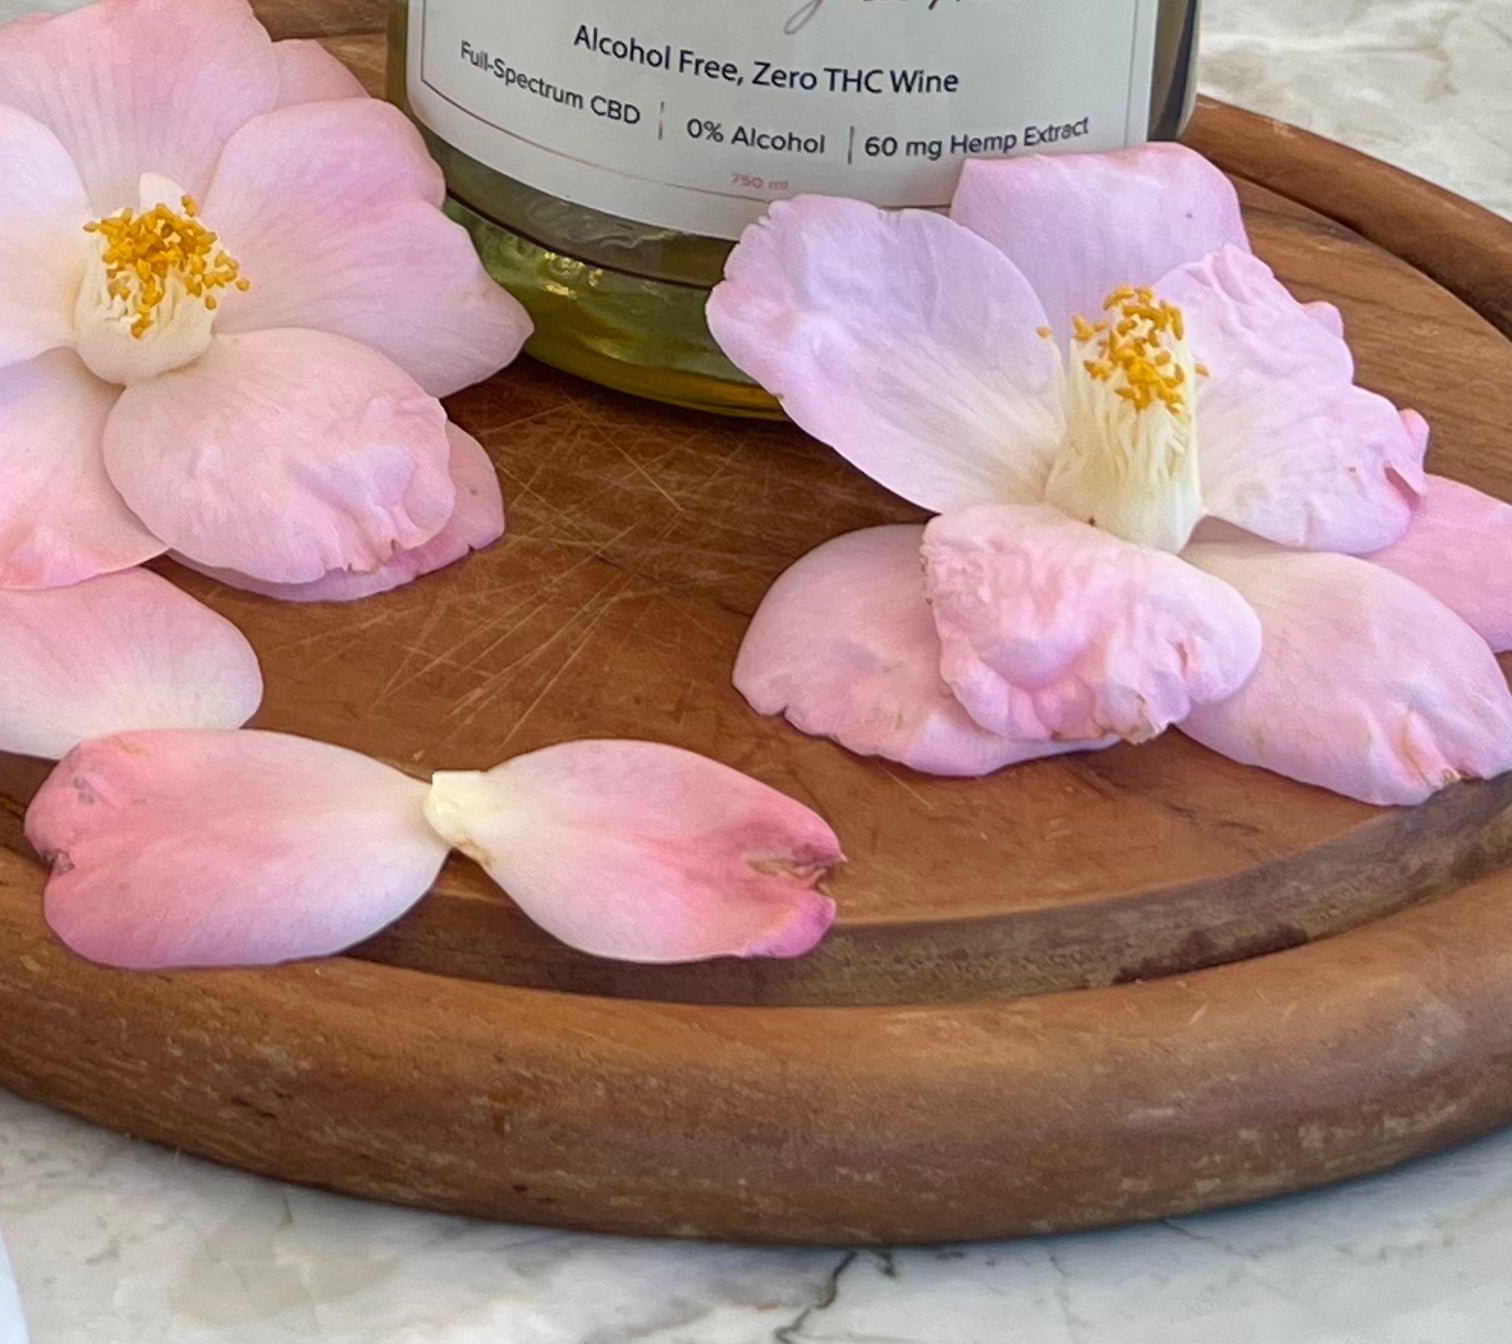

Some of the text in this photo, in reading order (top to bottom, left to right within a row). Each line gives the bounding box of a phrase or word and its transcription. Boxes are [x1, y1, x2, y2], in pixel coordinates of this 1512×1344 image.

[573, 24, 960, 95] Alcohol Free, Zero THC Wine
[460, 39, 1090, 161] Full-Spectrum CBD 0% Alcohol 60 mg Hemp Extract
[730, 172, 764, 189] 750
